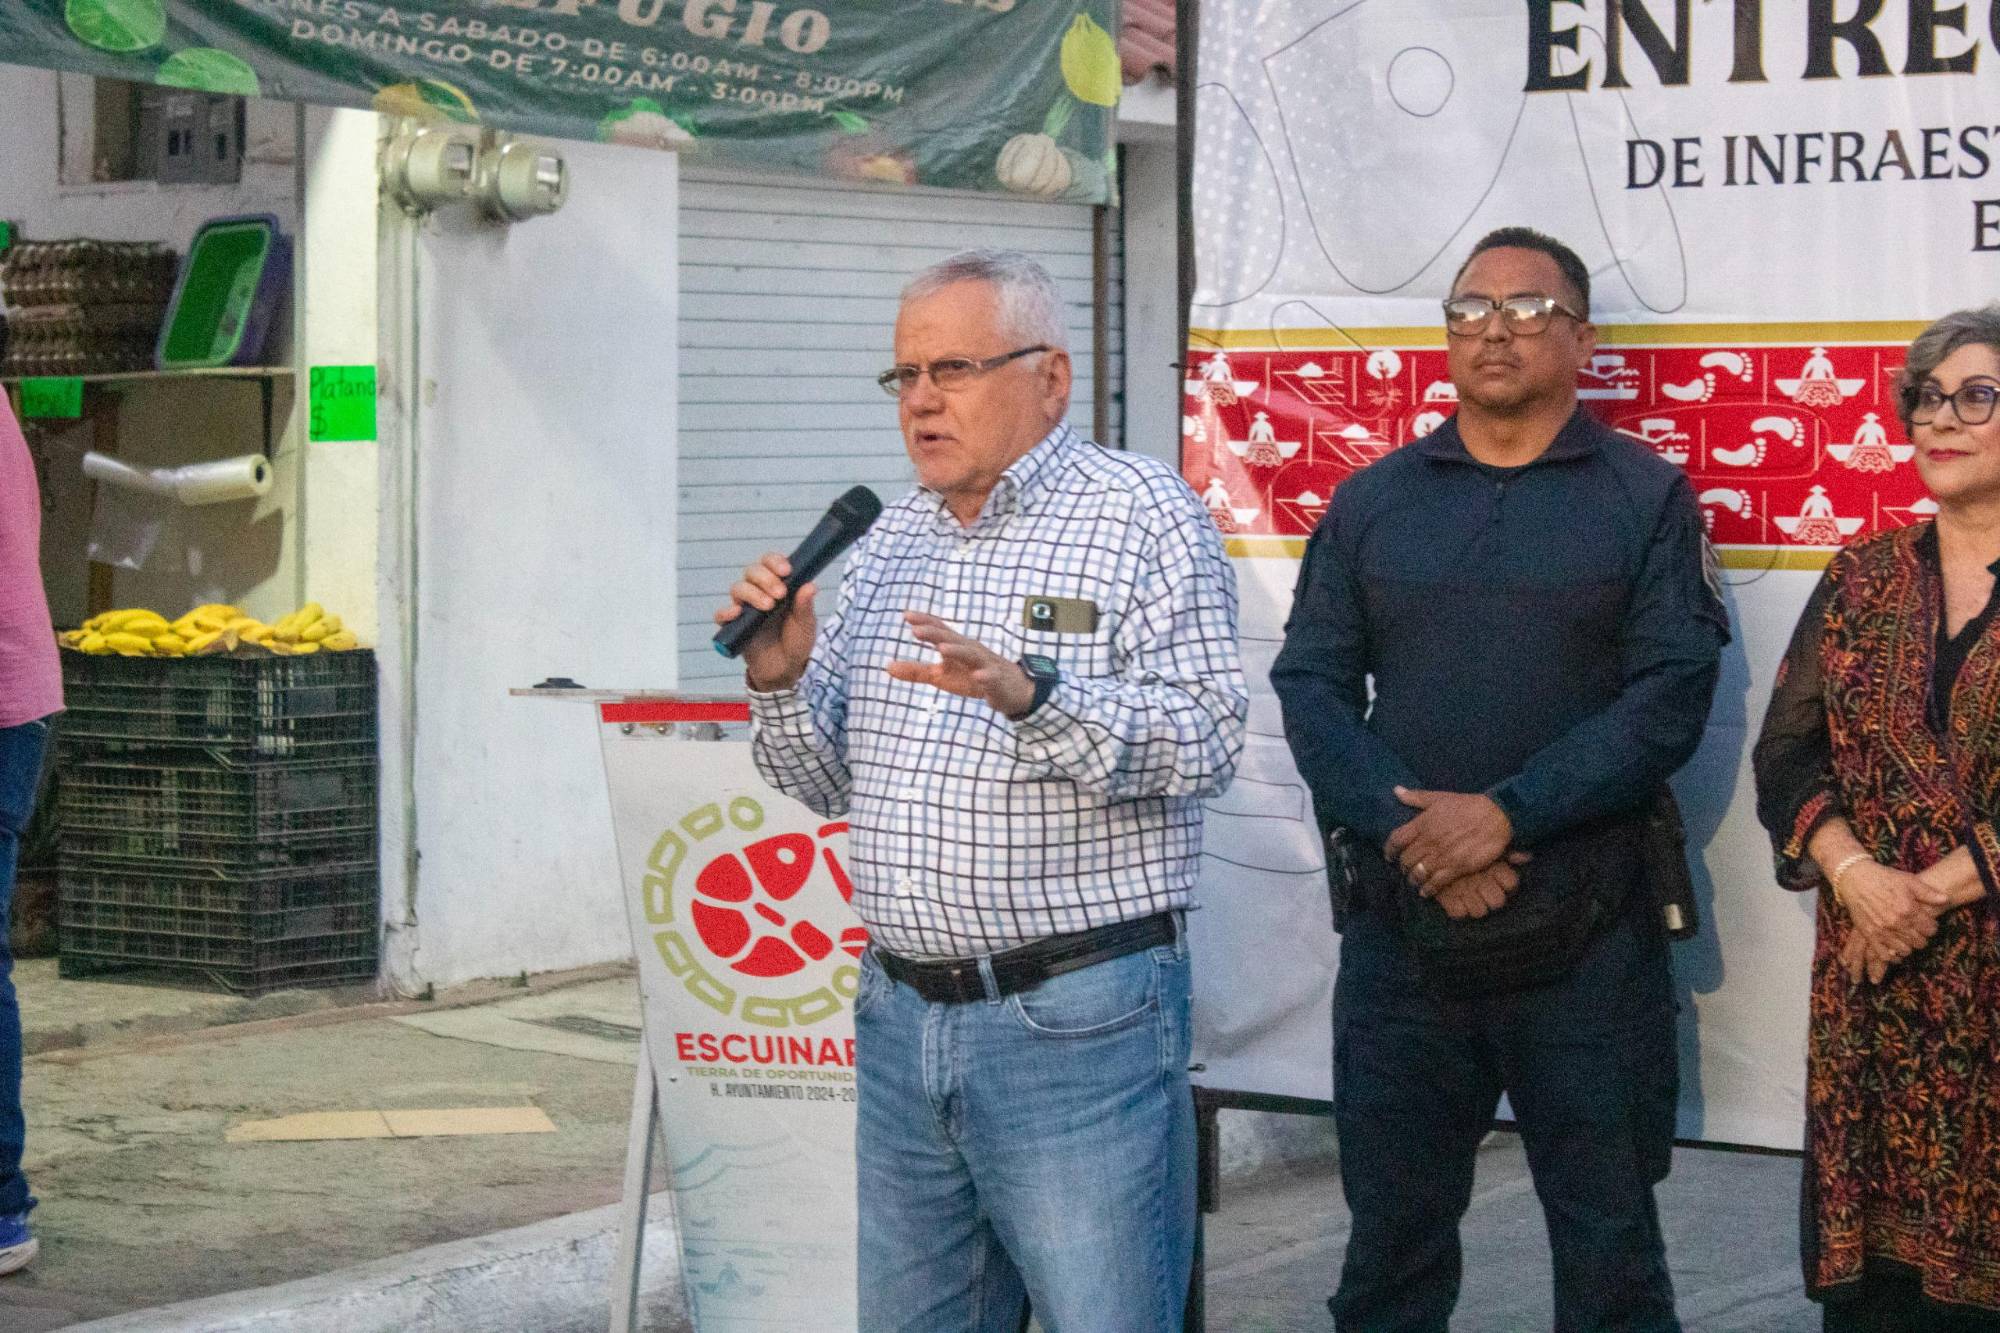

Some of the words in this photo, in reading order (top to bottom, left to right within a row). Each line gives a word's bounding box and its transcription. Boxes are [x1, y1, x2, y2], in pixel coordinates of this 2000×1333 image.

[291, 18, 471, 63] DOMINGO
[489, 48, 534, 74] DE
[551, 57, 674, 93] 7:00AM
[711, 82, 825, 114] 3:00PM
[377, 7, 401, 27] A
[417, 12, 567, 50] SABADO
[582, 38, 626, 61] DE
[641, 47, 760, 80] 6:00AM
[795, 71, 905, 102] 8:00PM
[1522, 0, 2000, 93] ENTRE
[1624, 136, 1705, 190] DE
[1722, 124, 2000, 187] INFRAES
[687, 1066, 738, 1078] TIERRA
[742, 1068, 761, 1079] DE
[725, 1083, 803, 1100] AYUNTAMIENTO
